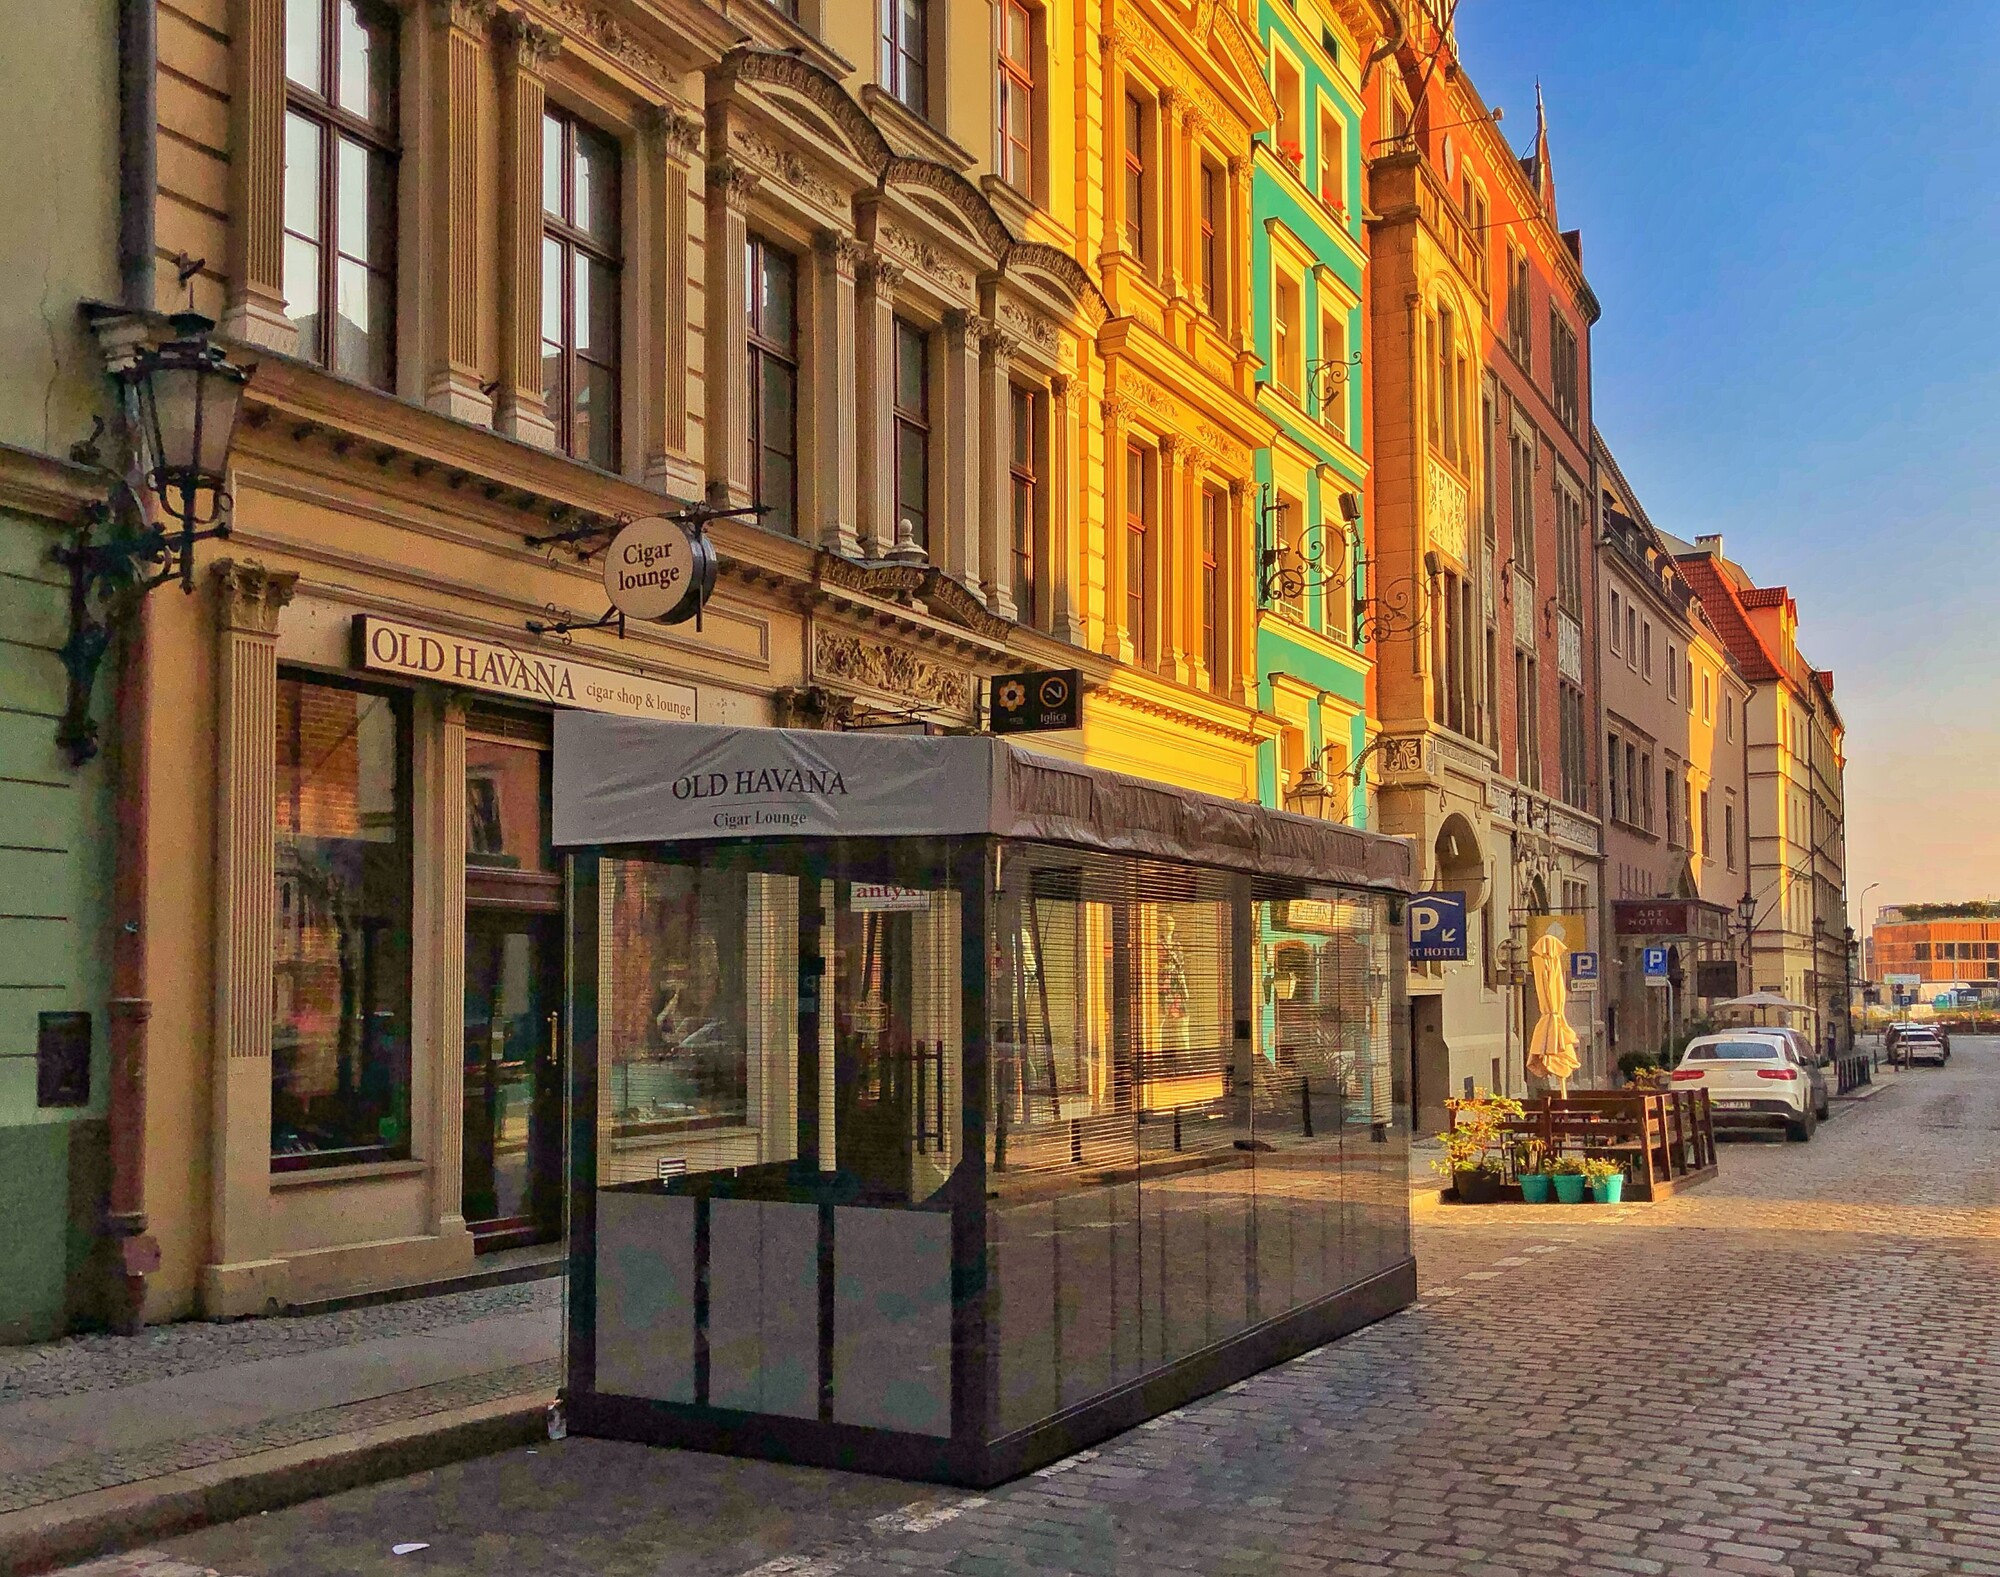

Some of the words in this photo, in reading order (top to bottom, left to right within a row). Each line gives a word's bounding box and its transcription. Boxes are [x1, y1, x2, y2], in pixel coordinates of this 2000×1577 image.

[623, 543, 672, 567] Cigar
[618, 567, 680, 591] lounge
[372, 627, 445, 673] OLD
[452, 644, 576, 701] HAVANA
[586, 685, 614, 703] cigar
[616, 687, 643, 710] shop
[645, 693, 655, 709] &
[656, 695, 692, 718] lounge
[672, 773, 729, 800] OLD
[734, 768, 849, 796] HAVANA
[713, 812, 751, 830] Cigar
[755, 810, 807, 828] Lounge
[1628, 918, 1673, 926] HOTEL
[1638, 909, 1664, 918] ART
[1411, 907, 1440, 943] P
[1424, 947, 1465, 957] HOTEL
[1649, 950, 1663, 968] P
[1577, 955, 1593, 975] P
